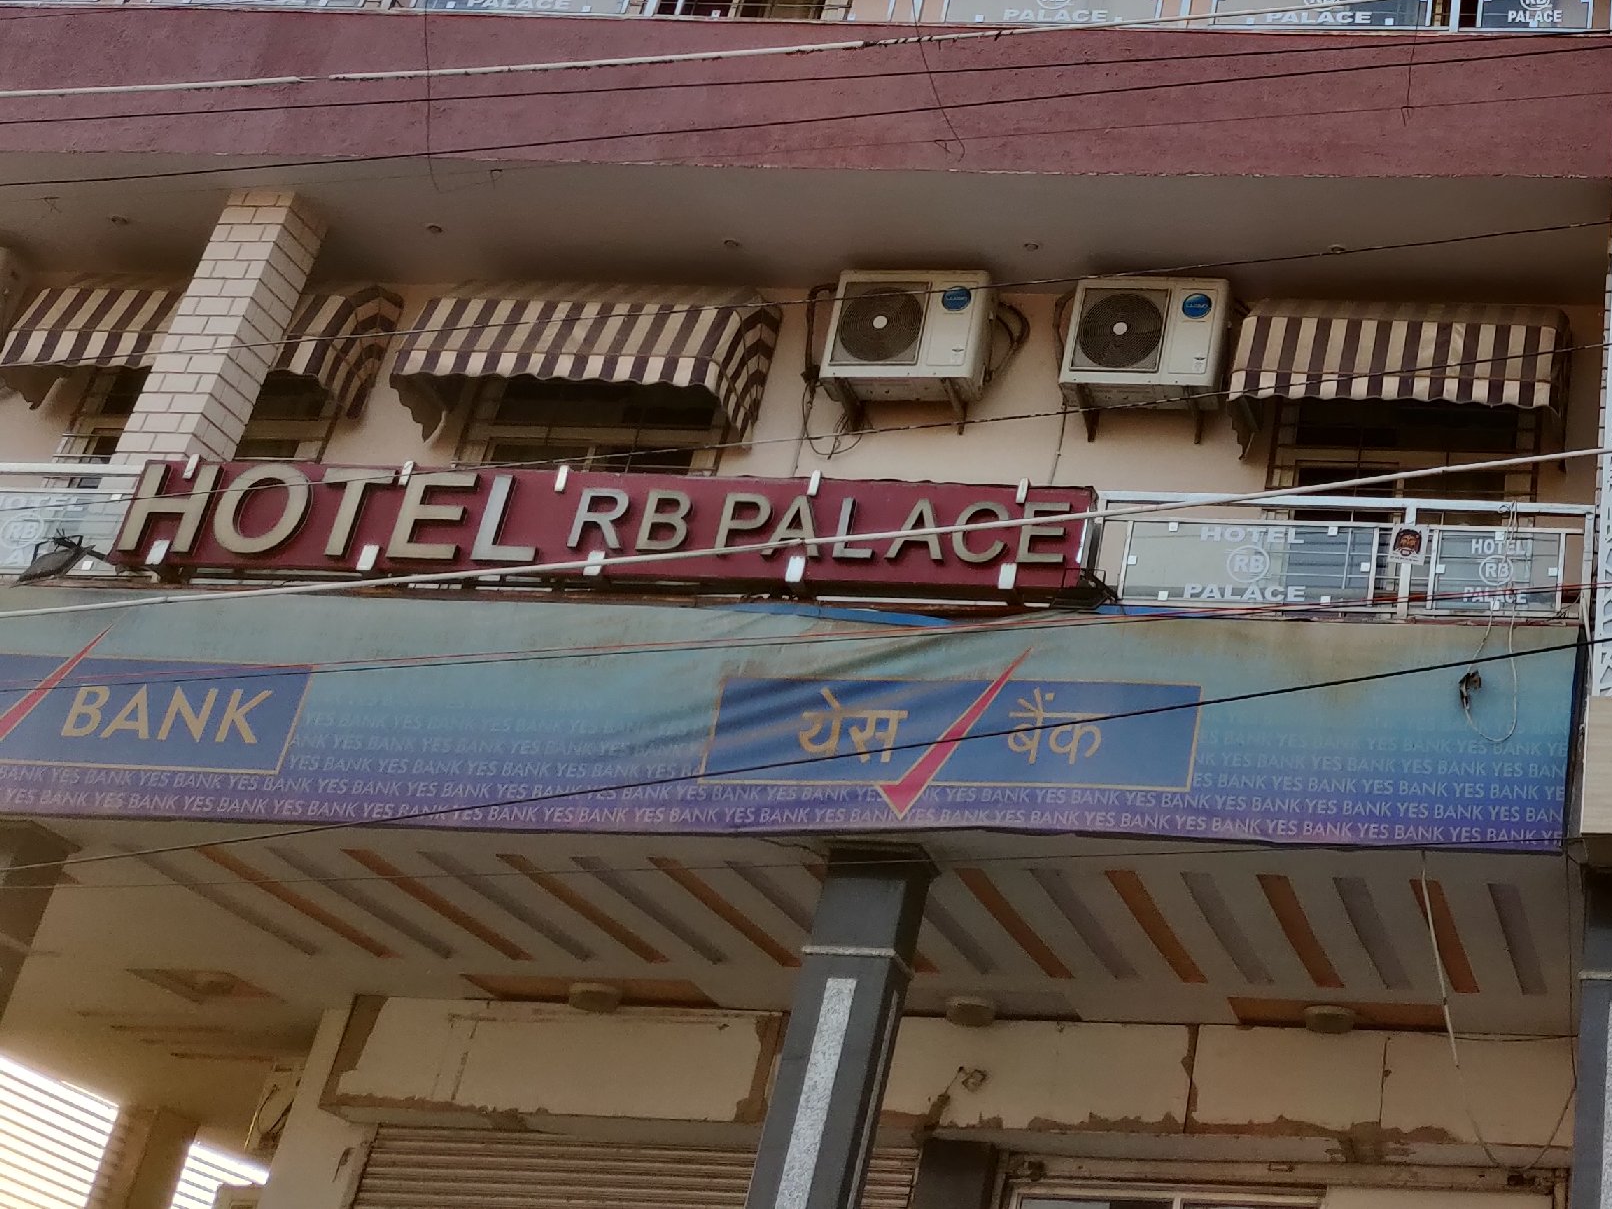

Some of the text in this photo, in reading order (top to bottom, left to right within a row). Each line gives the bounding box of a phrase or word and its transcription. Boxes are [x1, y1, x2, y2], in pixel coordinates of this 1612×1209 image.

[1002, 8, 1109, 23] PALACE
[1266, 12, 1373, 25] PALACE
[1507, 10, 1563, 23] PALACE
[115, 463, 1071, 565] HOTEL RB PALACE
[1200, 526, 1304, 544] HOTEL
[1471, 538, 1527, 554] HOTEL
[1232, 556, 1265, 573] RB
[1182, 584, 1306, 602] PALACE
[60, 683, 273, 744] BANK
[801, 687, 1112, 765] येस बैंक
[944, 786, 976, 802] YES
[980, 787, 1030, 802] BANK
[1034, 789, 1066, 804] YES
[1071, 790, 1120, 806] BANK
[1125, 791, 1156, 807] YES
[1161, 793, 1210, 809] BANK
[1214, 795, 1247, 811] YES
[1251, 797, 1301, 813] BANK
[1305, 798, 1337, 814] YES
[1342, 799, 1392, 816] BANK
[1396, 802, 1429, 819] YES
[1434, 803, 1484, 820] BANK
[1489, 806, 1520, 821] YES
[128, 794, 1479, 842] BANK YES BANK YES BANK YES BANK YES BANK YES BANK YES BANK YES BANK YES BANK YES BANK YES BANK YES BANK YES BANK YES
